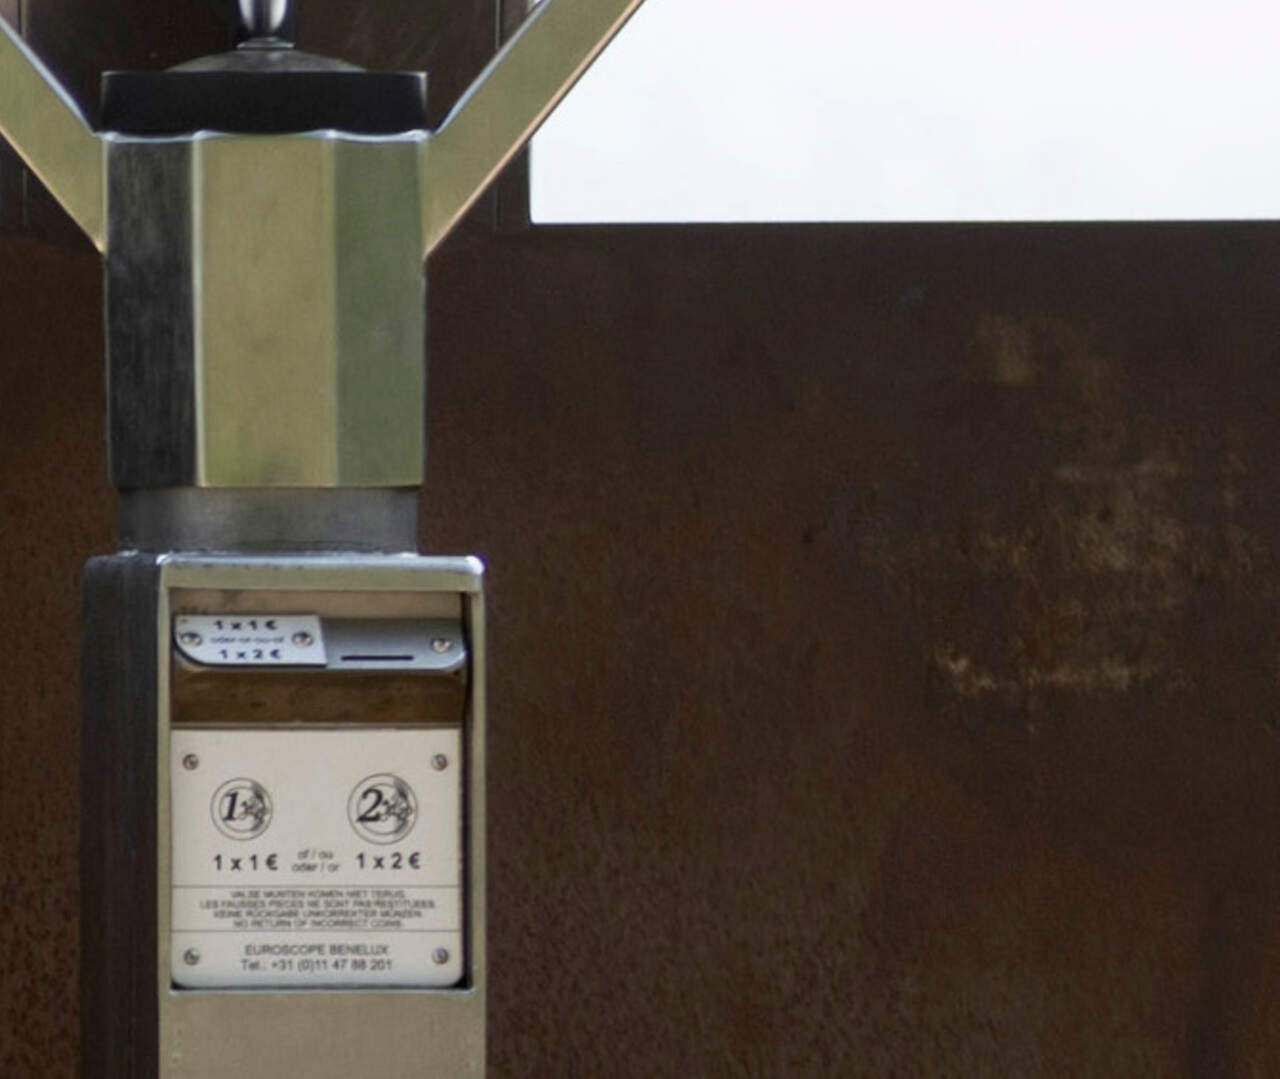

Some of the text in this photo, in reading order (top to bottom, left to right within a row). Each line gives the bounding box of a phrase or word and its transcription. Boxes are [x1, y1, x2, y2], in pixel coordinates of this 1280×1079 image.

[214, 620, 224, 630] 1
[248, 620, 258, 630] 1
[219, 649, 281, 659] 1 x 2 €
[222, 792, 238, 821] 1
[356, 788, 384, 822] 2
[213, 854, 279, 871] 1 x 1 €
[356, 852, 421, 869] 1 x 2 €
[244, 944, 390, 956] EUROSCOPE BENELUX
[271, 959, 293, 971] +31
[297, 958, 328, 972] (0)11
[332, 959, 348, 971] 47
[370, 959, 393, 971] 201
